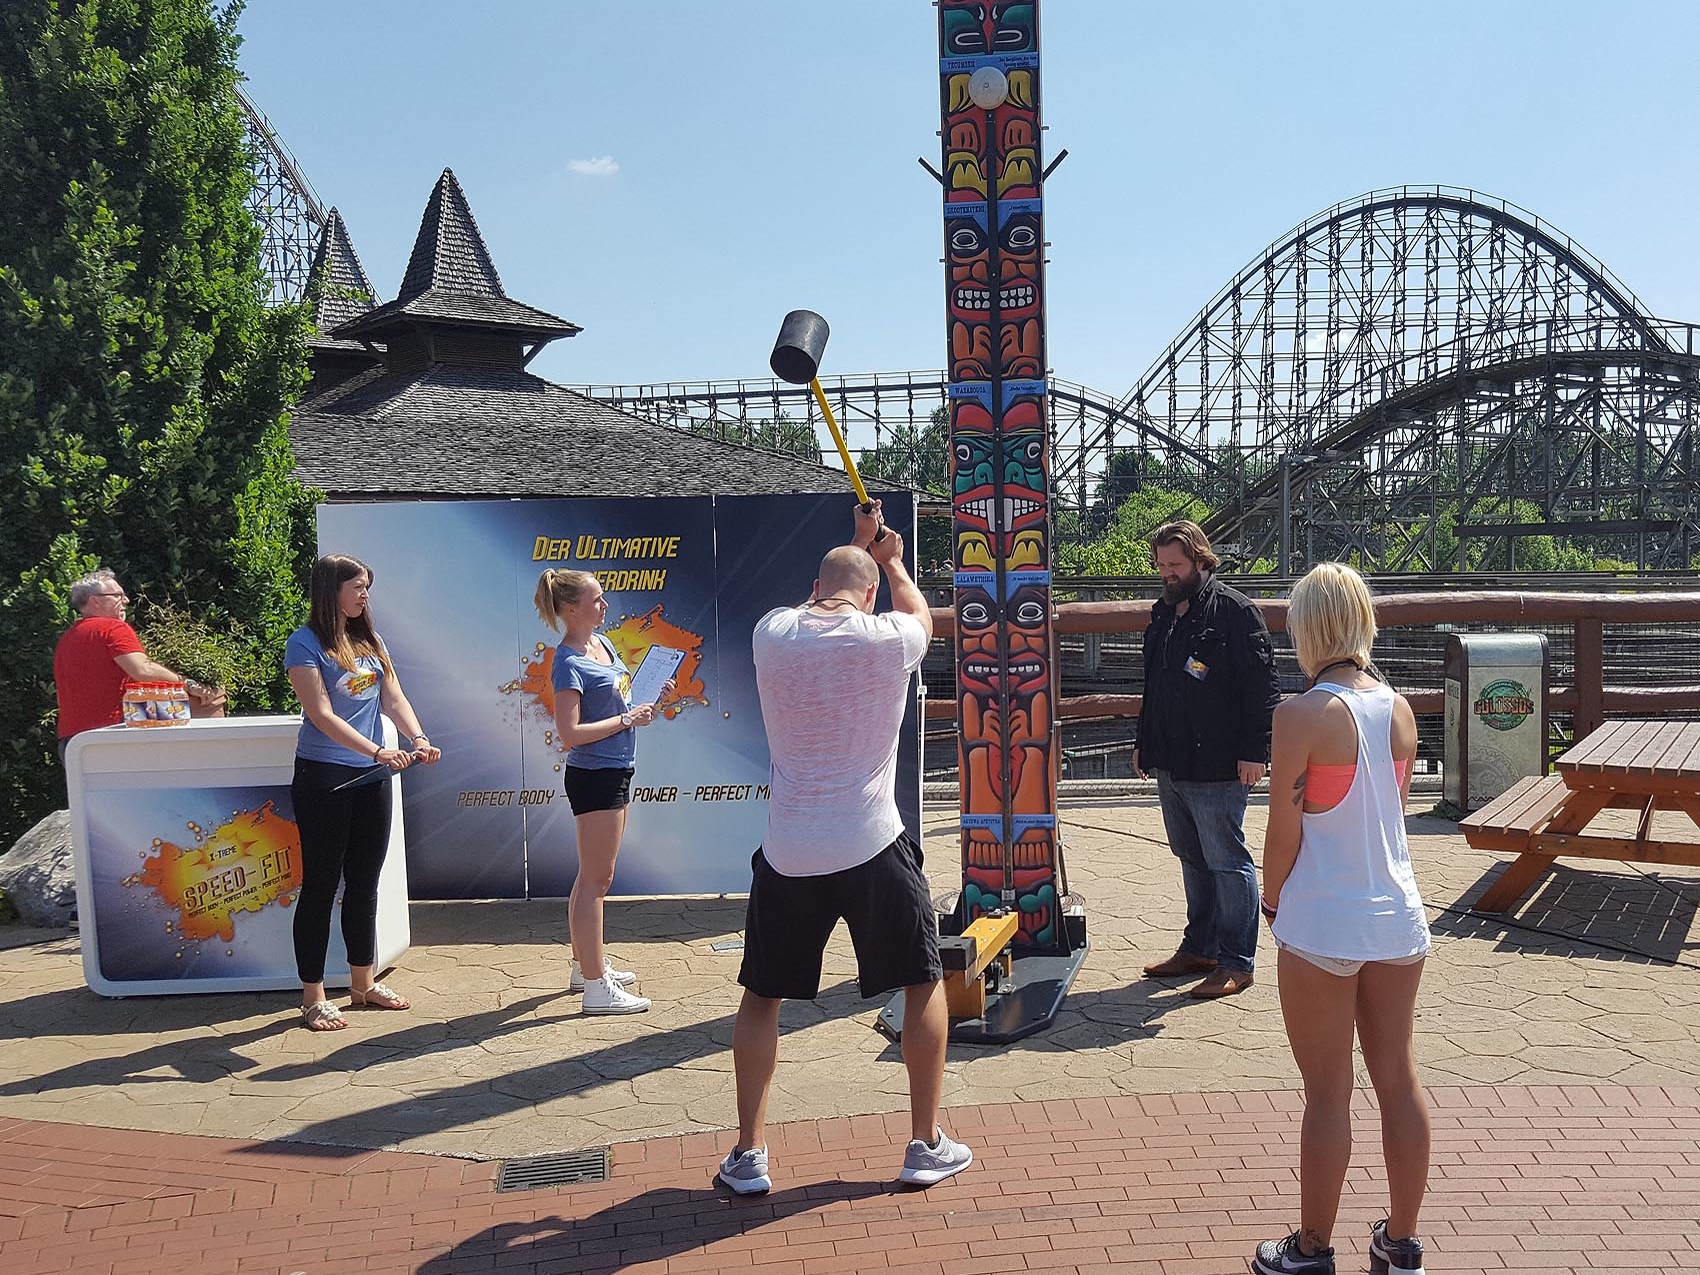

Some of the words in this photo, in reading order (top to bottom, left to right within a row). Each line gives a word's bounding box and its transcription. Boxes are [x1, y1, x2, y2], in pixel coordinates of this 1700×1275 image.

[575, 535, 681, 560] ULTIMATIVE
[591, 568, 667, 592] ERDRINK
[457, 790, 515, 807] PERFECT
[518, 789, 555, 806] BODY
[632, 786, 678, 803] POWER
[694, 784, 753, 802] PERFECT
[209, 845, 238, 862] X-TREME
